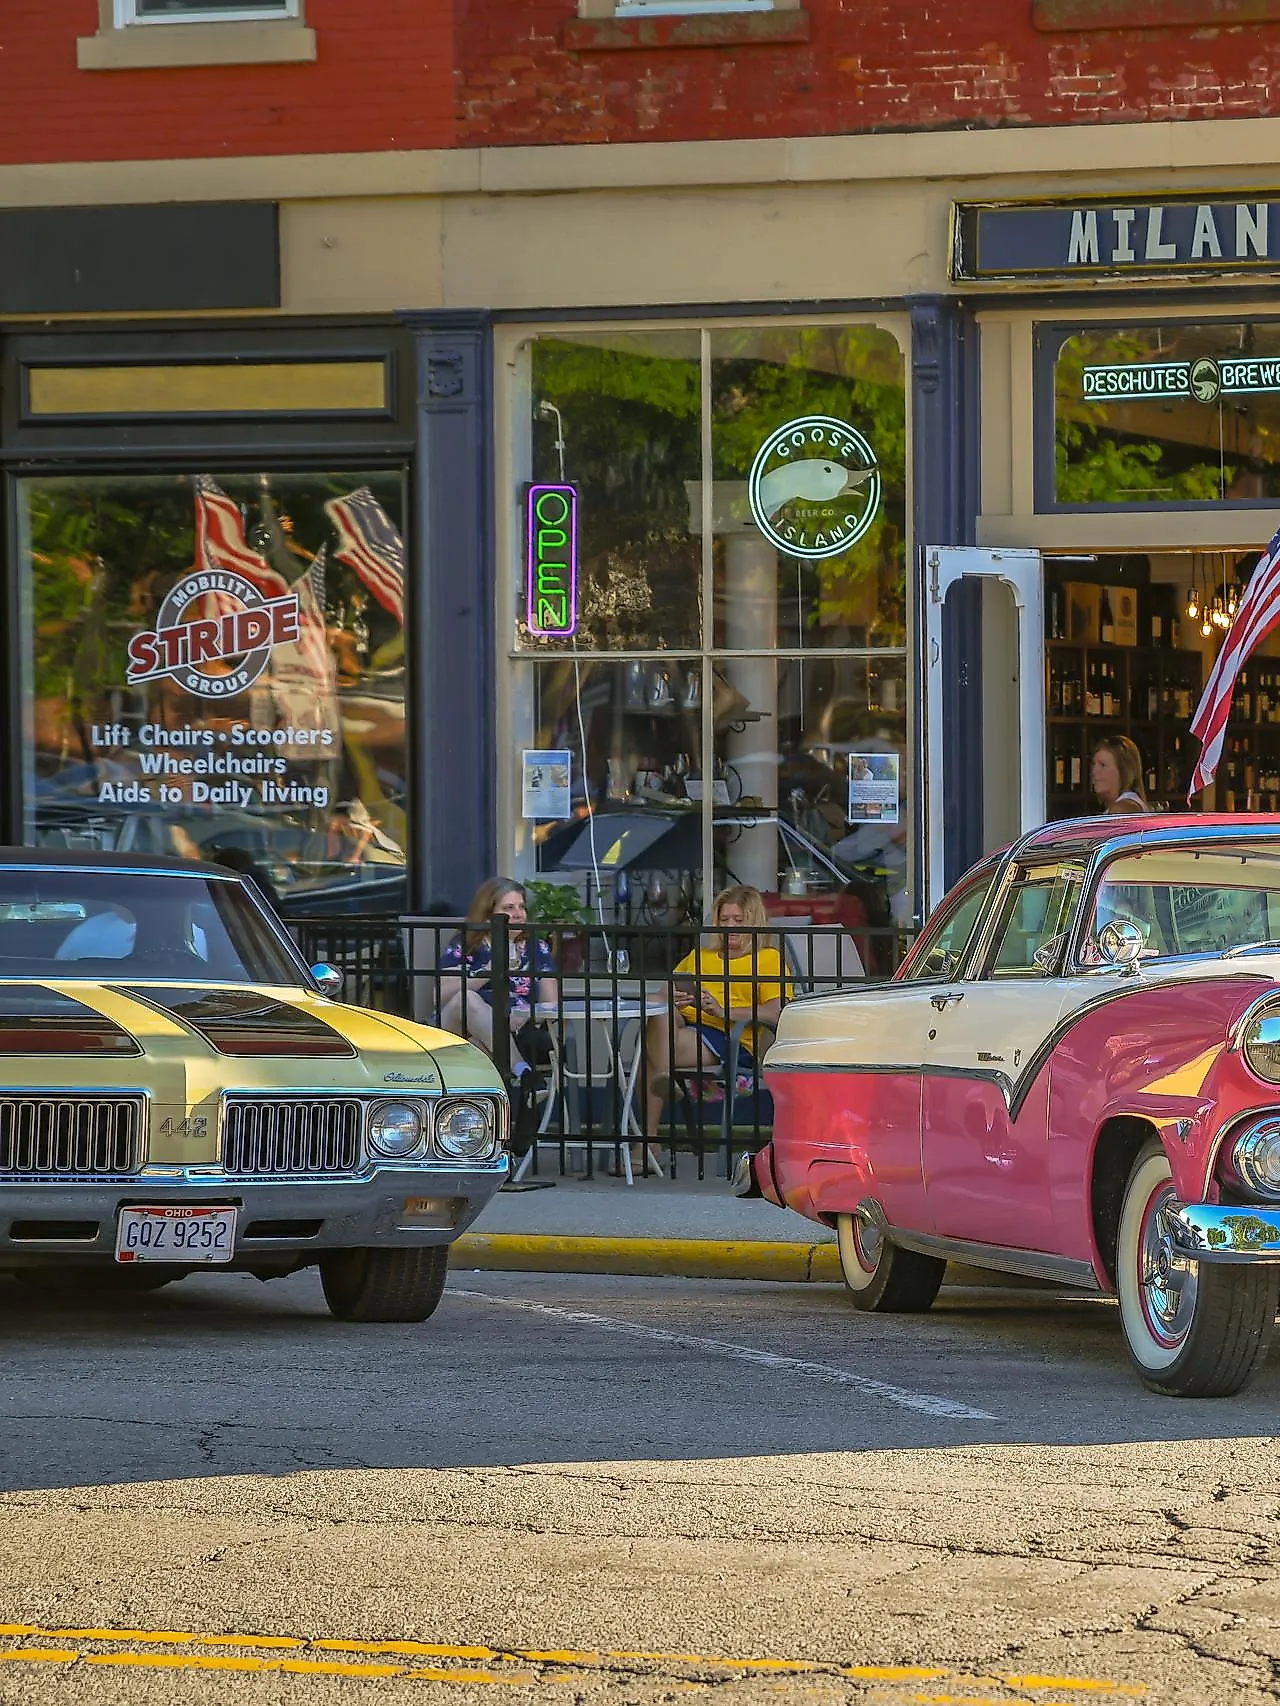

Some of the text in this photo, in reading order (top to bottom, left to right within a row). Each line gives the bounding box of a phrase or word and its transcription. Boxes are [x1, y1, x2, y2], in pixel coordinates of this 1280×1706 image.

[1067, 203, 1268, 263] MILAN
[1083, 369, 1189, 392] DESCHUTES
[776, 427, 856, 457] GOOSE
[795, 509, 818, 518] BEER
[775, 514, 858, 548] ISLAND
[536, 493, 569, 628] OPEN
[171, 575, 257, 608] MOBILITY
[127, 601, 299, 677] STRIDE
[186, 670, 250, 694] GROUP
[92, 724, 333, 746] Lift Chairs Scooters
[139, 752, 287, 774] Wheelchairs
[99, 780, 329, 808] Aids to Daily living
[160, 1117, 207, 1138] 442
[165, 1209, 193, 1217] OHIO
[127, 1222, 227, 1248] GQZ 9252
